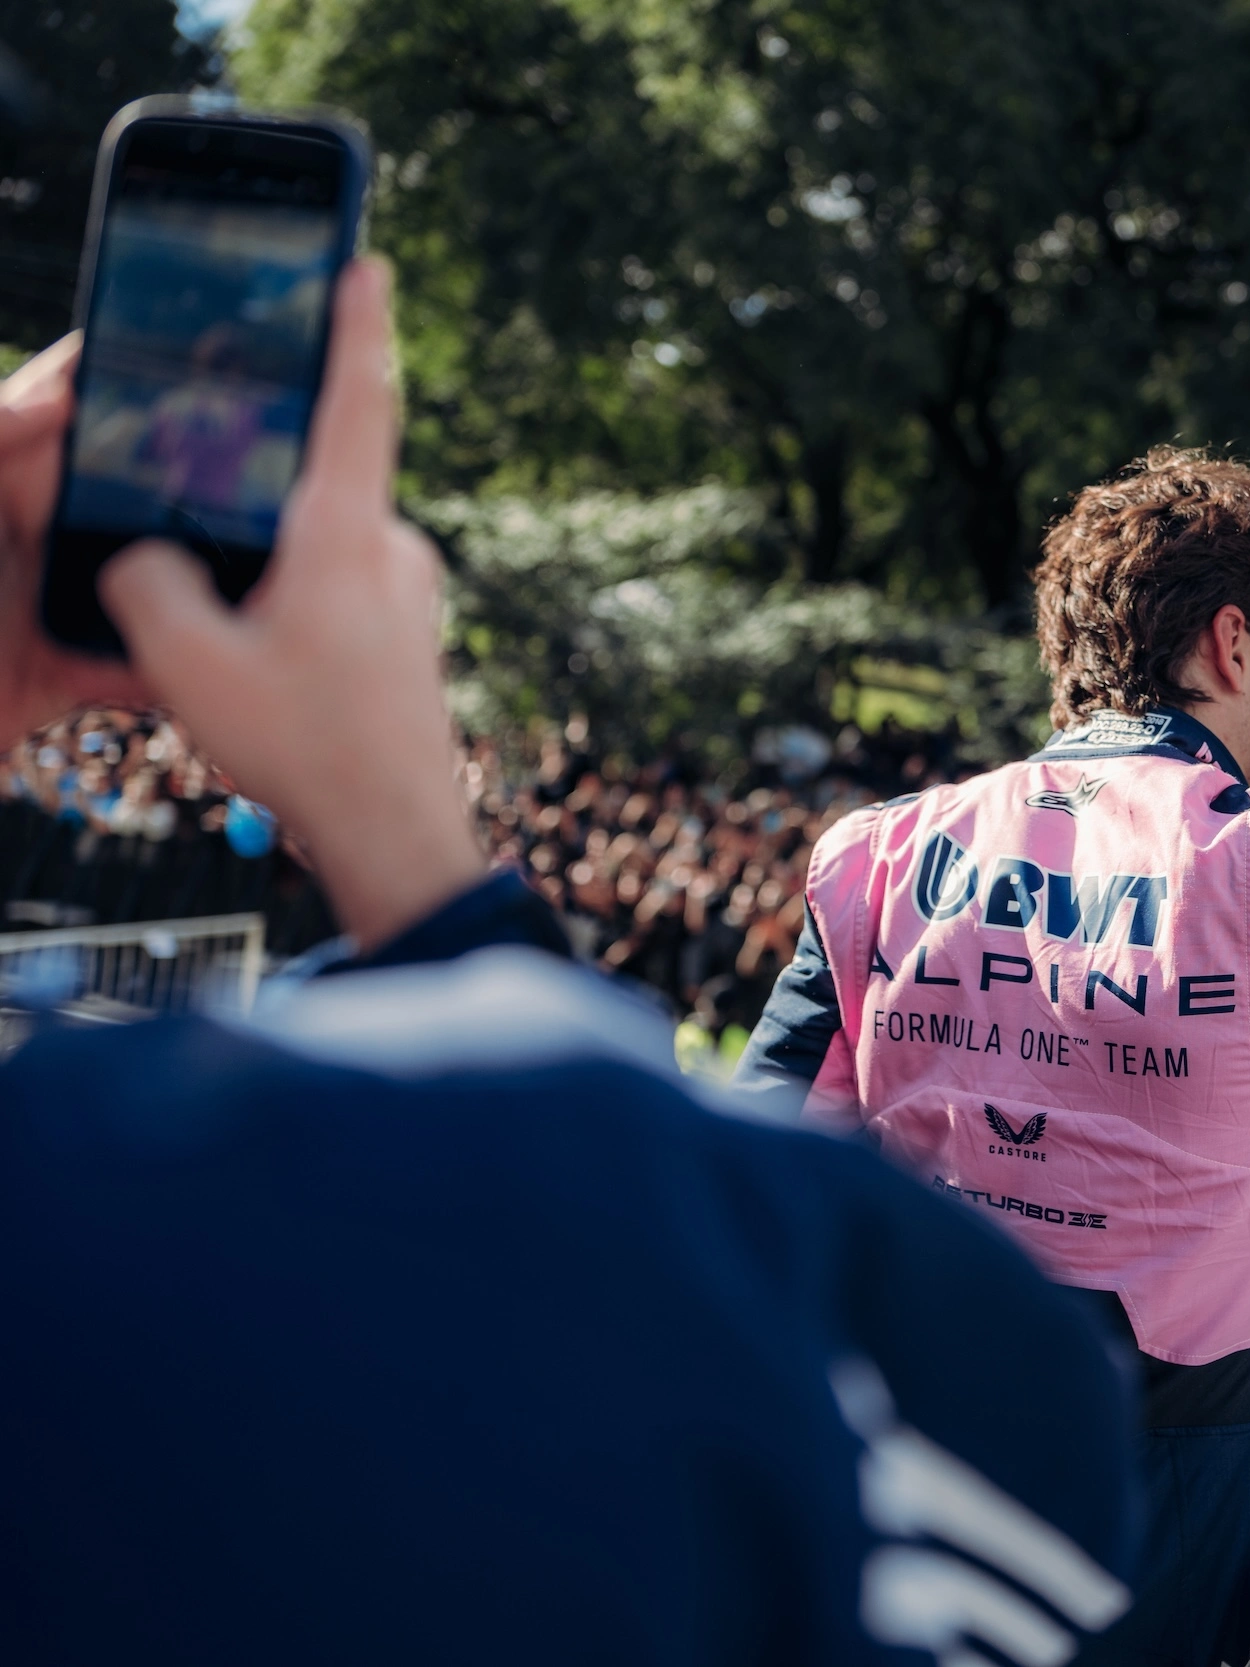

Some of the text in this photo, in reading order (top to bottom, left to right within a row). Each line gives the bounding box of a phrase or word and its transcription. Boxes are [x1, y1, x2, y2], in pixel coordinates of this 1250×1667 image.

[982, 856, 1168, 949] BWT
[874, 1010, 1002, 1055] FORMULA
[1104, 1042, 1189, 1077] TEAM
[988, 1145, 1047, 1162] CASTORE
